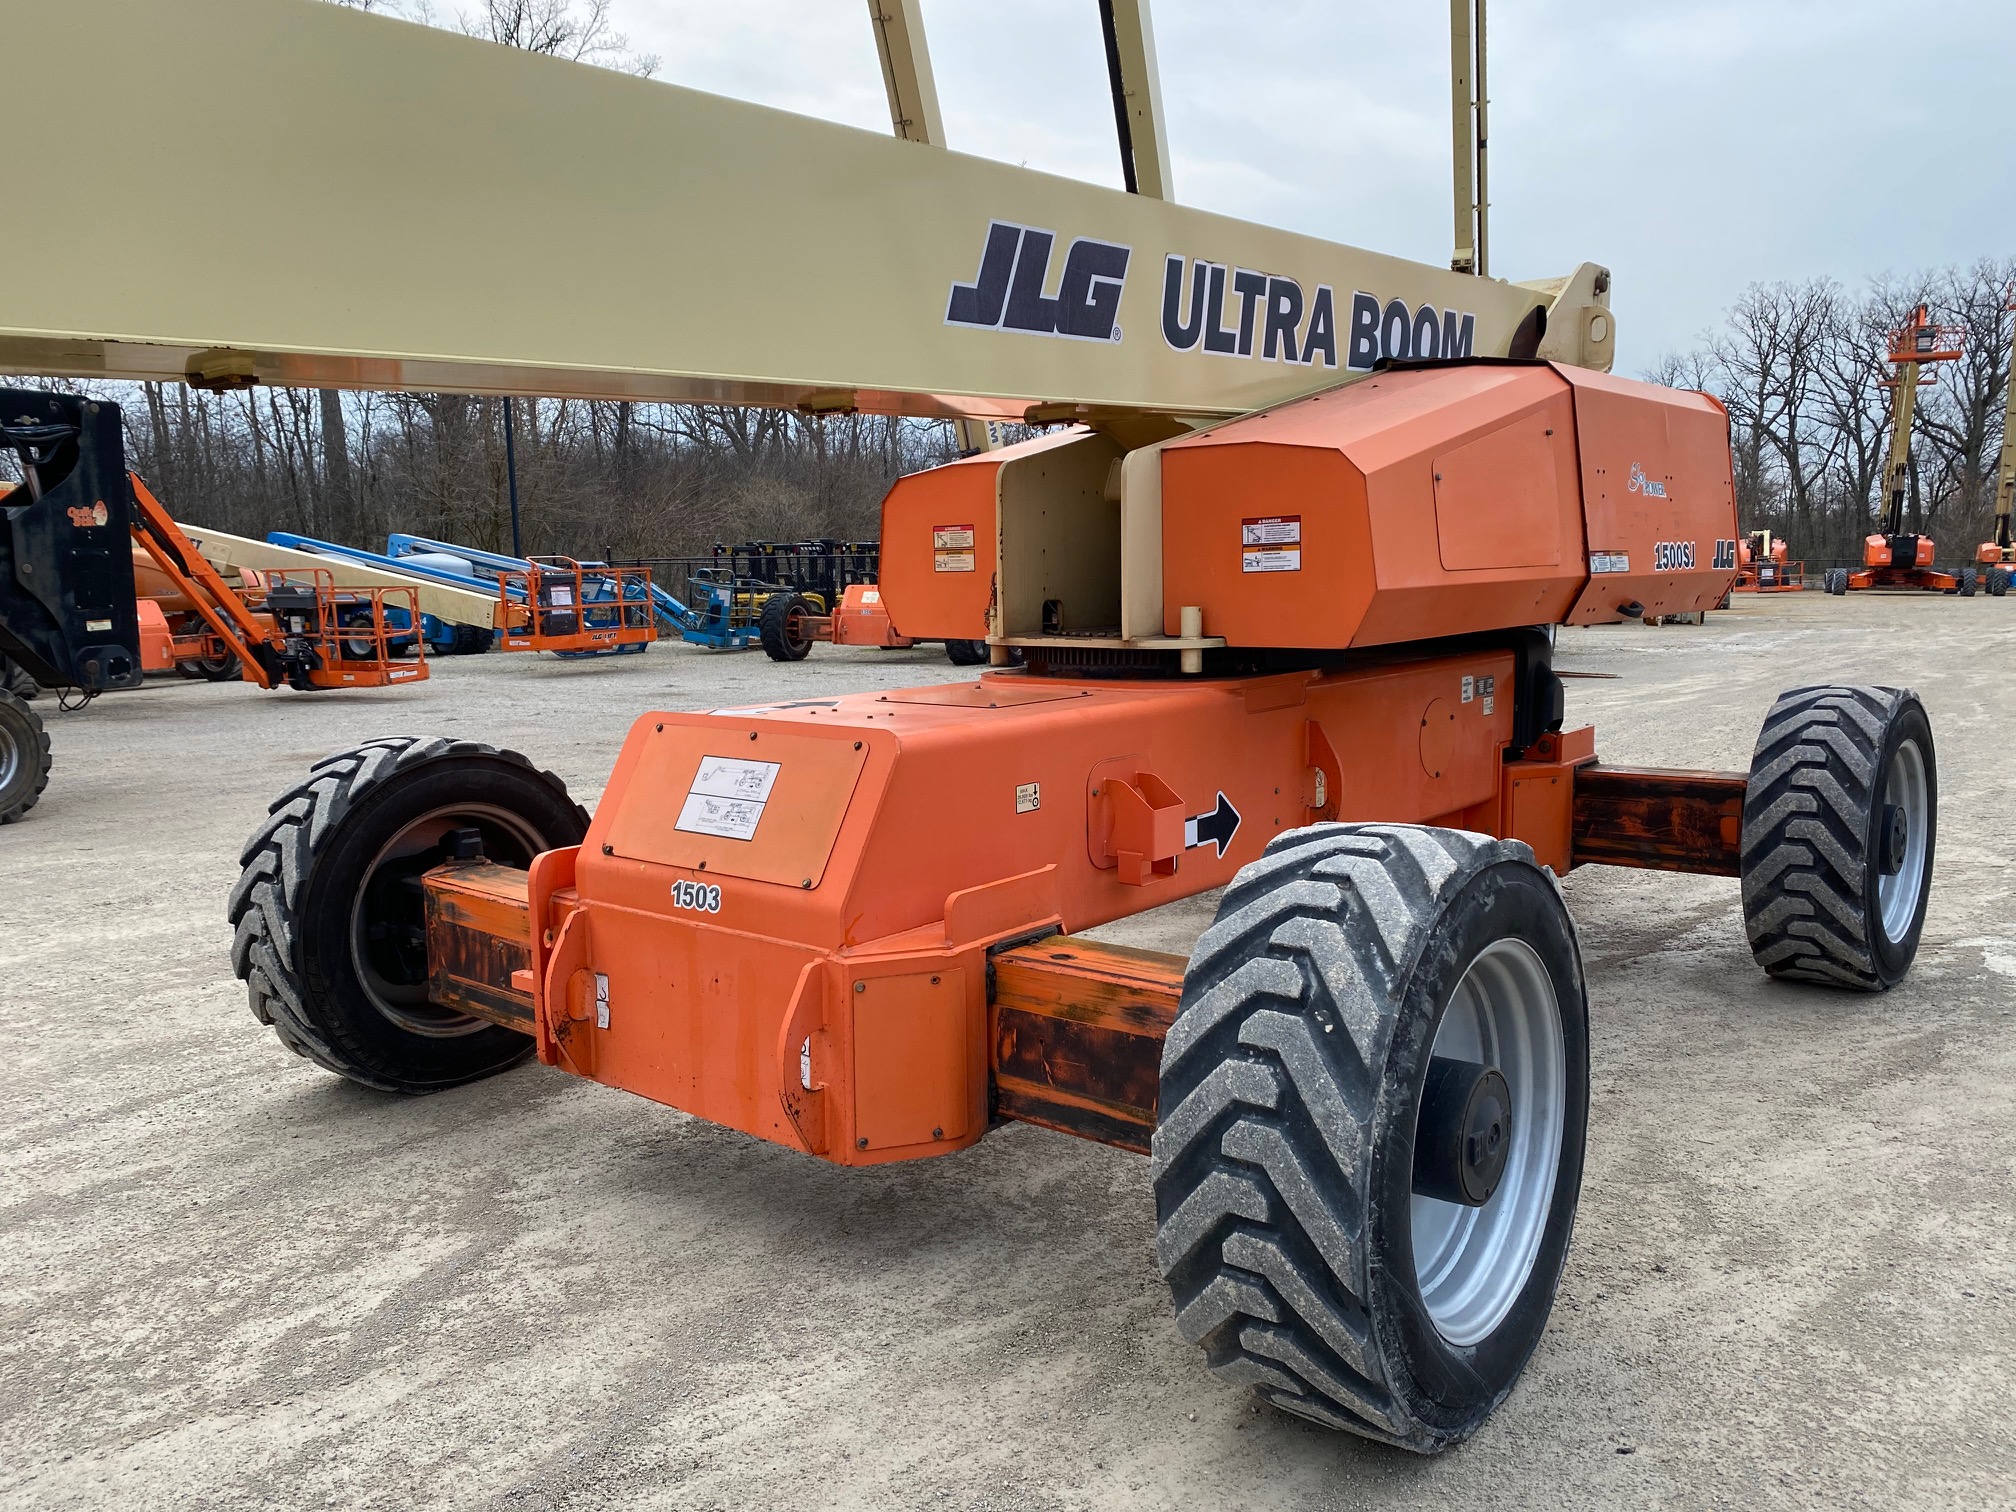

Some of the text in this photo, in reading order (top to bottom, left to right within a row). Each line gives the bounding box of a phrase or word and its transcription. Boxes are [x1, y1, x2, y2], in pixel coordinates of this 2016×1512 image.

[943, 218, 1132, 343] JLG
[1159, 252, 1476, 372] ULTRA BOOM
[1654, 541, 1695, 571] 1500SJ
[1712, 539, 1736, 569] JLG
[671, 879, 721, 914] 1503
